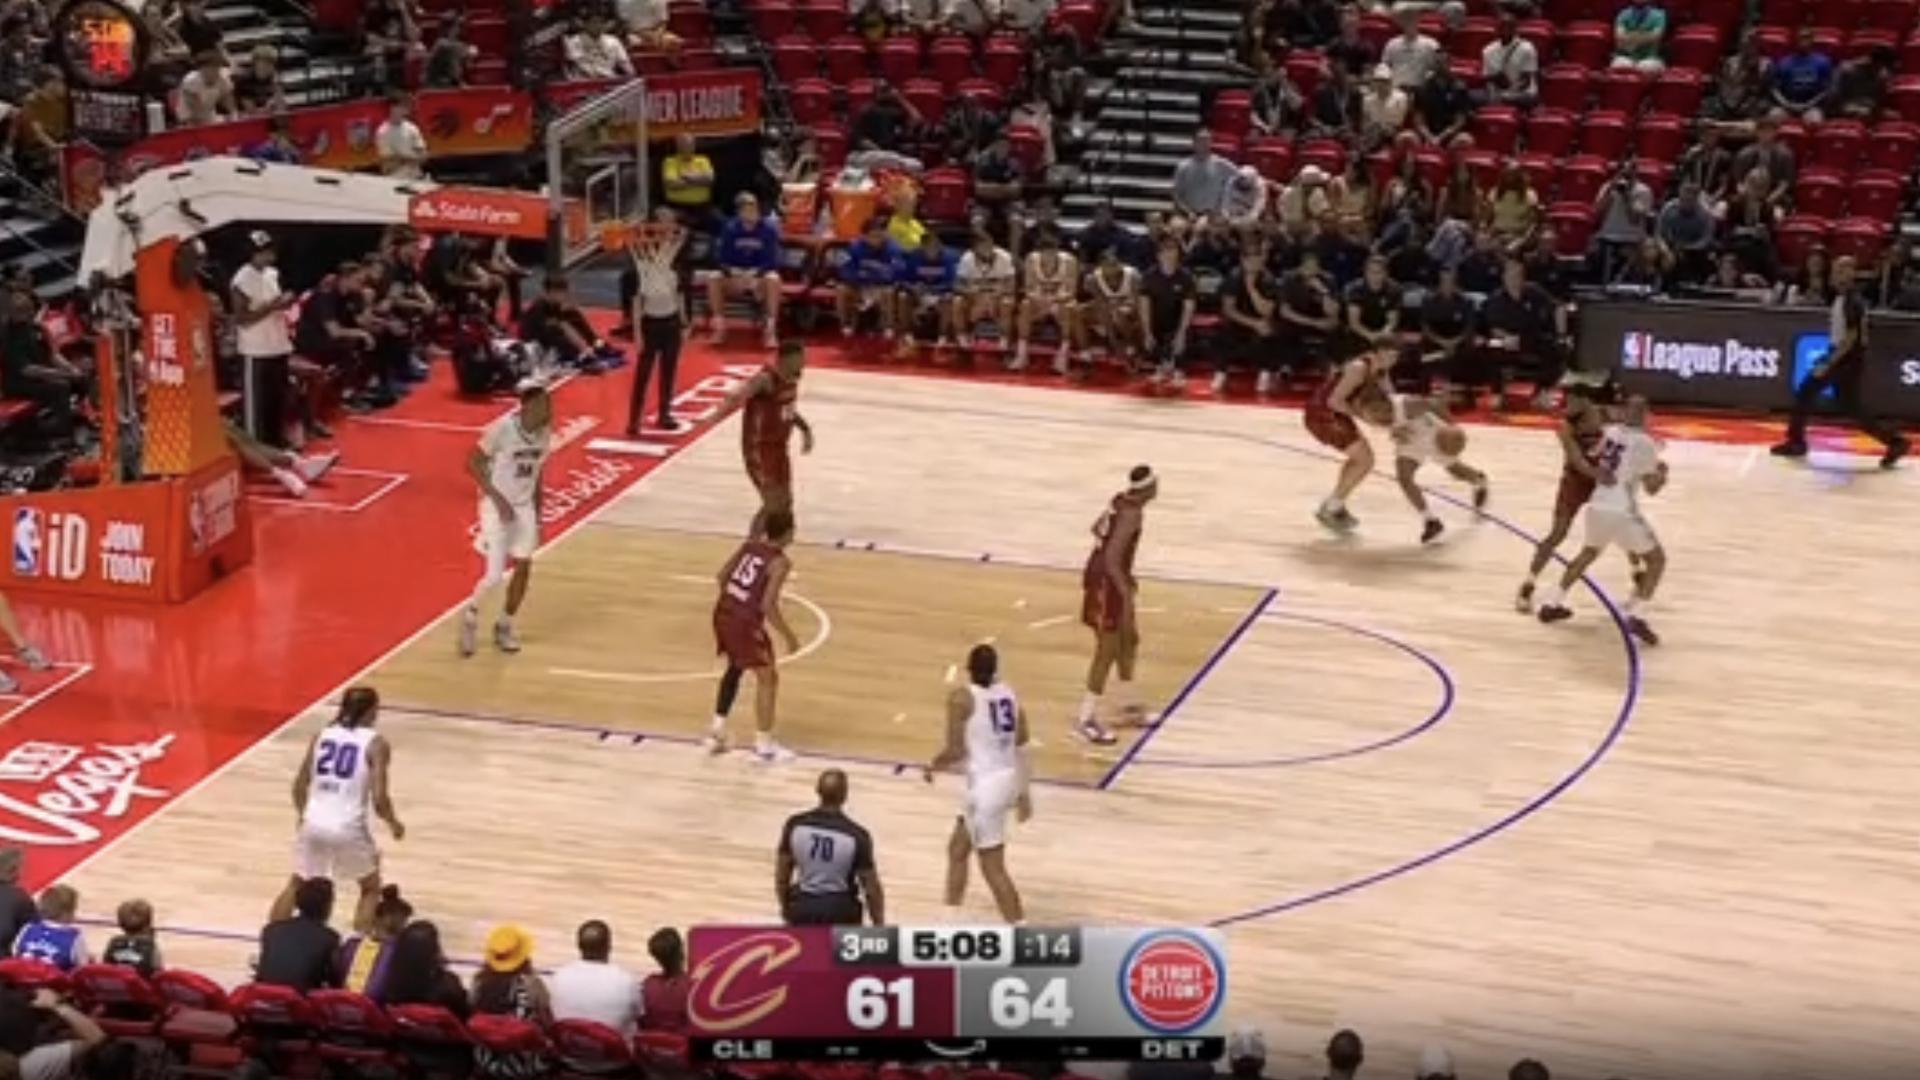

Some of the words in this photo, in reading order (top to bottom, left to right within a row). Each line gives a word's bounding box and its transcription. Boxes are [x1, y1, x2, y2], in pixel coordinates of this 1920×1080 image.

[1646, 333, 1721, 378] League
[1724, 339, 1780, 378] Pass
[100, 519, 144, 551] JOIN
[100, 552, 155, 586] TODAY
[989, 698, 1016, 734] 13
[317, 738, 359, 779] 20
[810, 832, 834, 862] 70
